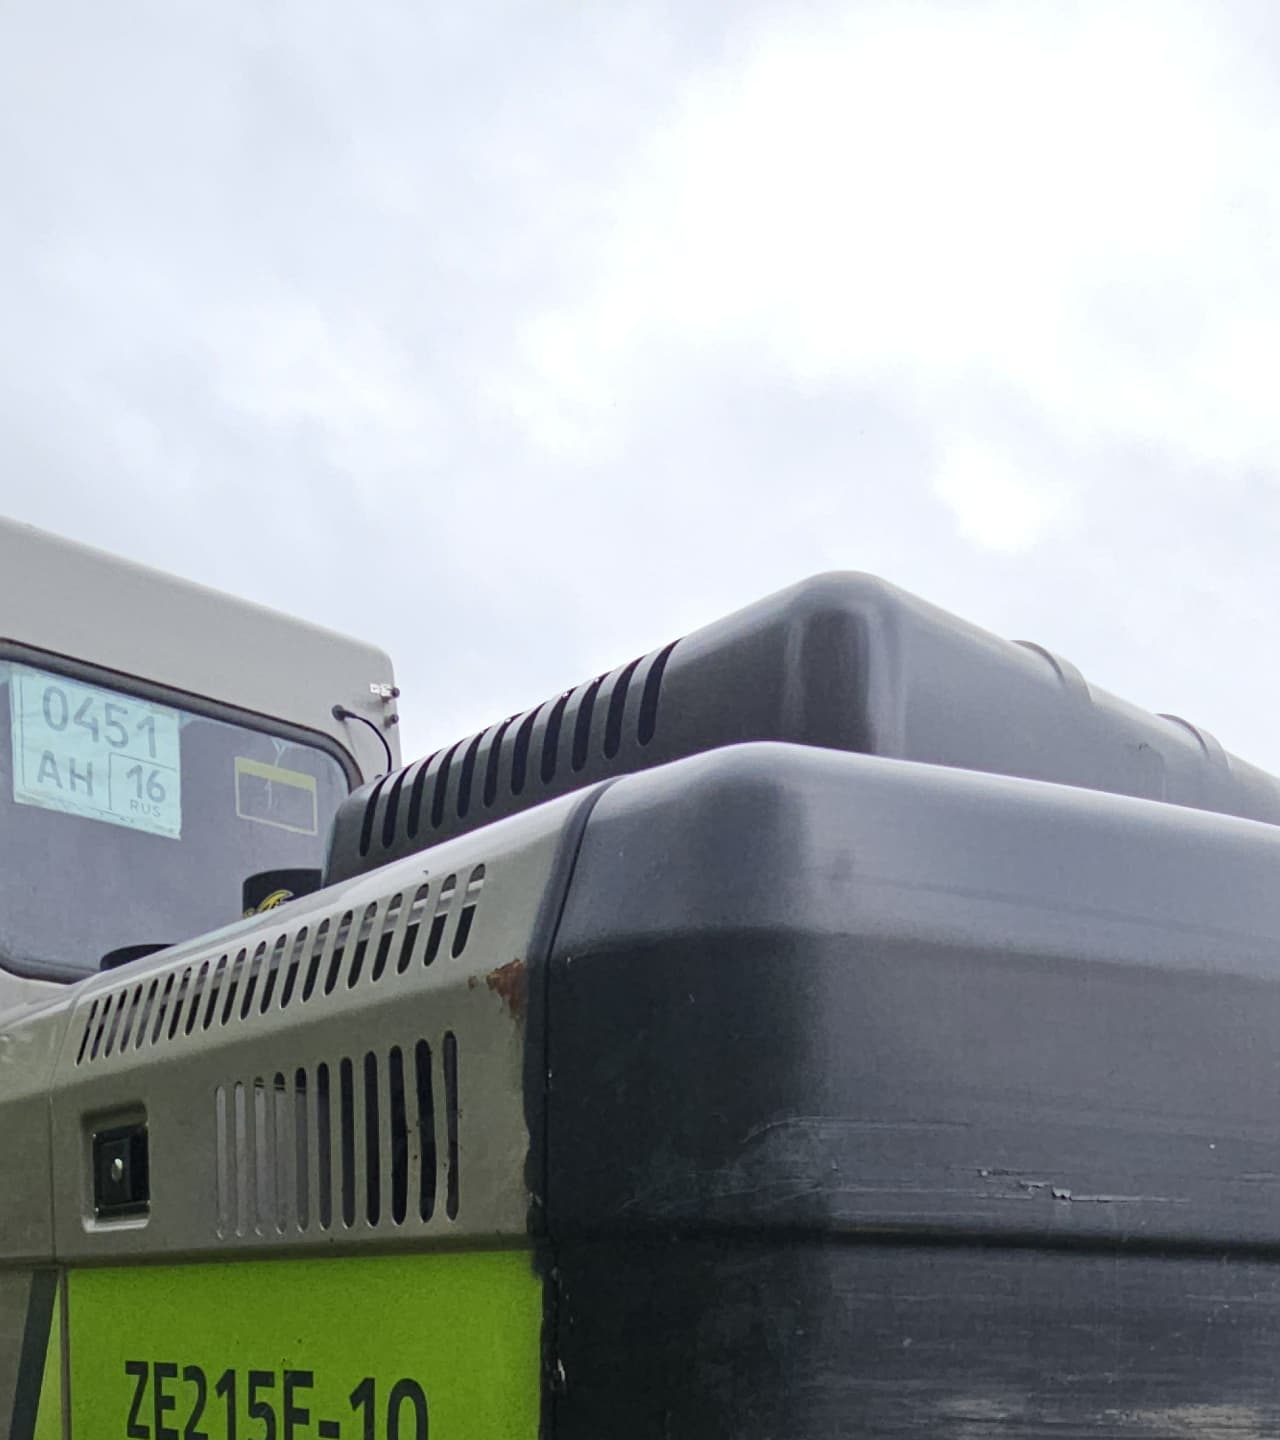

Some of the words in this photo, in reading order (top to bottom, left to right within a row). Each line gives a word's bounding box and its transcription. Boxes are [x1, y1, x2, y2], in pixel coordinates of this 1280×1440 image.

[43, 686, 156, 758] 0451
[126, 764, 166, 803] 16
[130, 800, 161, 818] RUS
